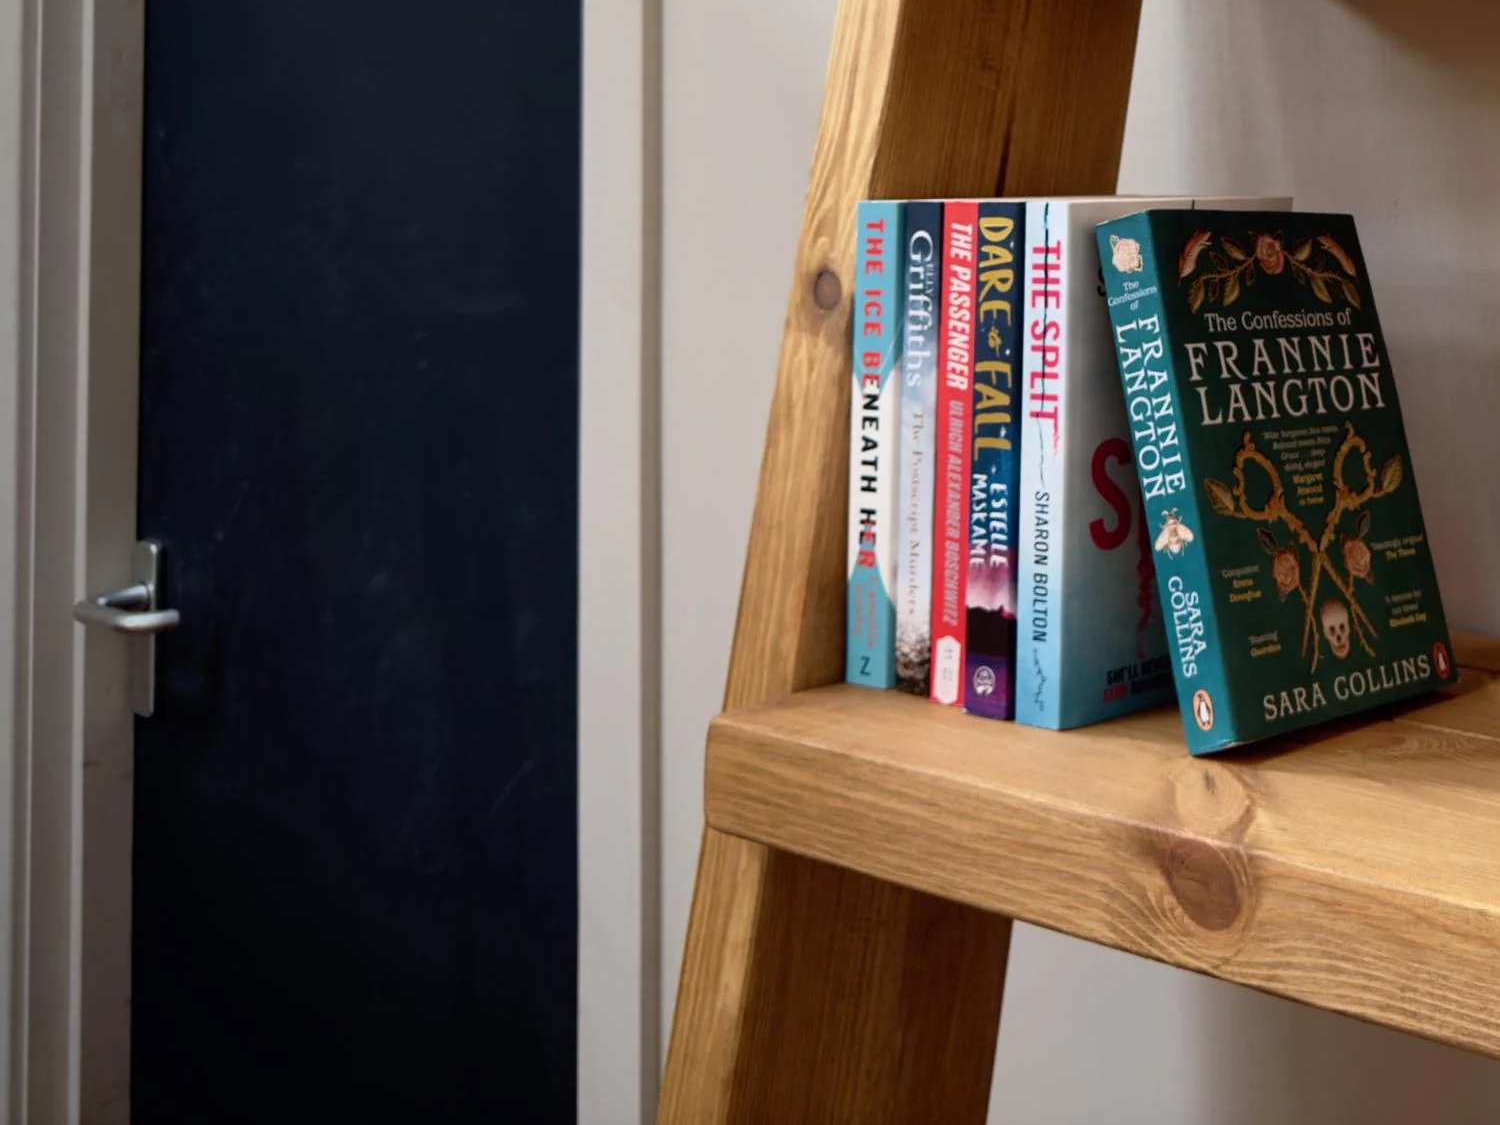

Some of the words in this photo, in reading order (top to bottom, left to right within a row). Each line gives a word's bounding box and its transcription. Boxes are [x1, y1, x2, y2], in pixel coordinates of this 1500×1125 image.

[865, 219, 884, 275] THE
[950, 222, 973, 262] THE
[978, 216, 1015, 326] DARE
[1031, 241, 1061, 309] THE
[863, 289, 883, 337] ICE
[905, 230, 934, 388] Griffiths
[1107, 285, 1158, 307] Confessions
[1122, 280, 1139, 292] The
[1130, 300, 1140, 311] of
[1204, 312, 1237, 333] The
[1241, 309, 1334, 331] Confessions
[1337, 308, 1352, 325] of
[945, 265, 972, 392] PASSENGER
[1184, 332, 1380, 382] FRANNIE
[1029, 320, 1060, 425] SPLIT
[1138, 314, 1187, 494] FRANNIE
[1195, 373, 1386, 425] LANGTON
[860, 351, 881, 493] BENEATH
[912, 412, 924, 442] The
[948, 400, 965, 451] ULRICH
[973, 360, 1012, 462] FALL
[1115, 320, 1168, 500] LANGTON
[944, 454, 963, 538] ALEXANDER
[969, 473, 988, 568] MASKAME
[990, 482, 1009, 568] ESTELLE
[1034, 490, 1050, 566] SHARON
[857, 508, 877, 568] HER
[907, 540, 922, 616] Murders
[942, 539, 961, 627] BOSCHWITZ
[1032, 572, 1049, 643] BOLTON
[1167, 576, 1198, 678] COLLINS
[1185, 591, 1207, 656] SARA
[1263, 681, 1328, 721] SARA
[1333, 654, 1431, 700] COLLINS
